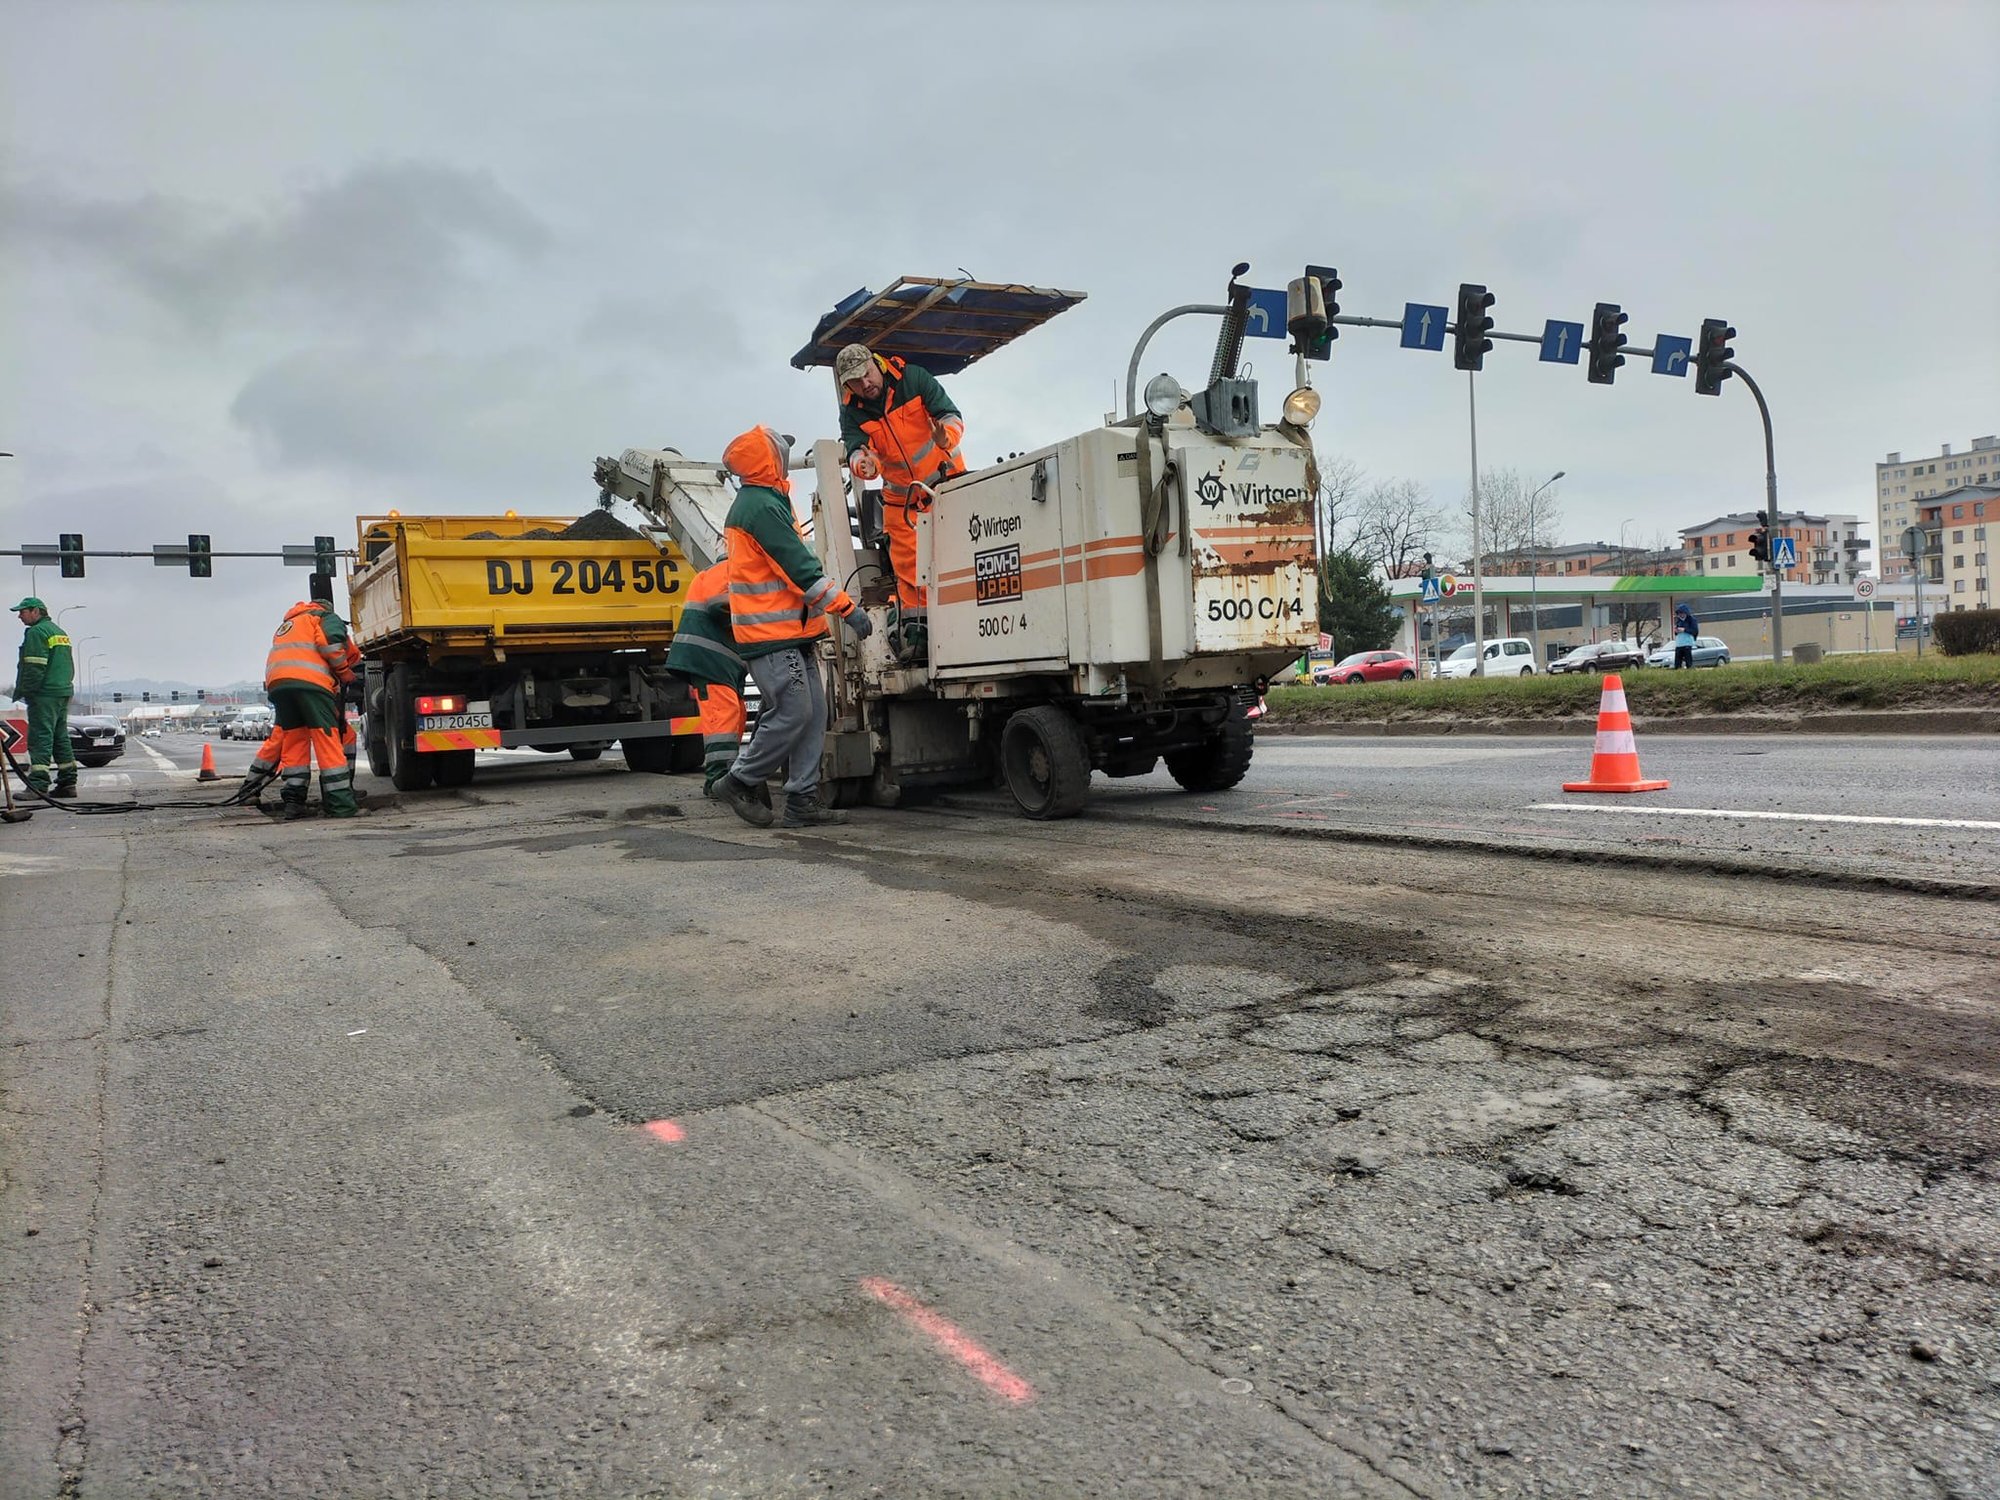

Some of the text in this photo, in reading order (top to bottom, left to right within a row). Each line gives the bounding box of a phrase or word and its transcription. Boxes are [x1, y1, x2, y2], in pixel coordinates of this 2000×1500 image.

[1230, 483, 1308, 506] Wirtgen
[983, 515, 1021, 538] Wirtgen
[486, 559, 534, 595] DJ
[1860, 585, 1871, 593] 40
[1208, 598, 1253, 622] 500
[979, 617, 1000, 637] 500
[426, 715, 490, 730] DJ 2045C
